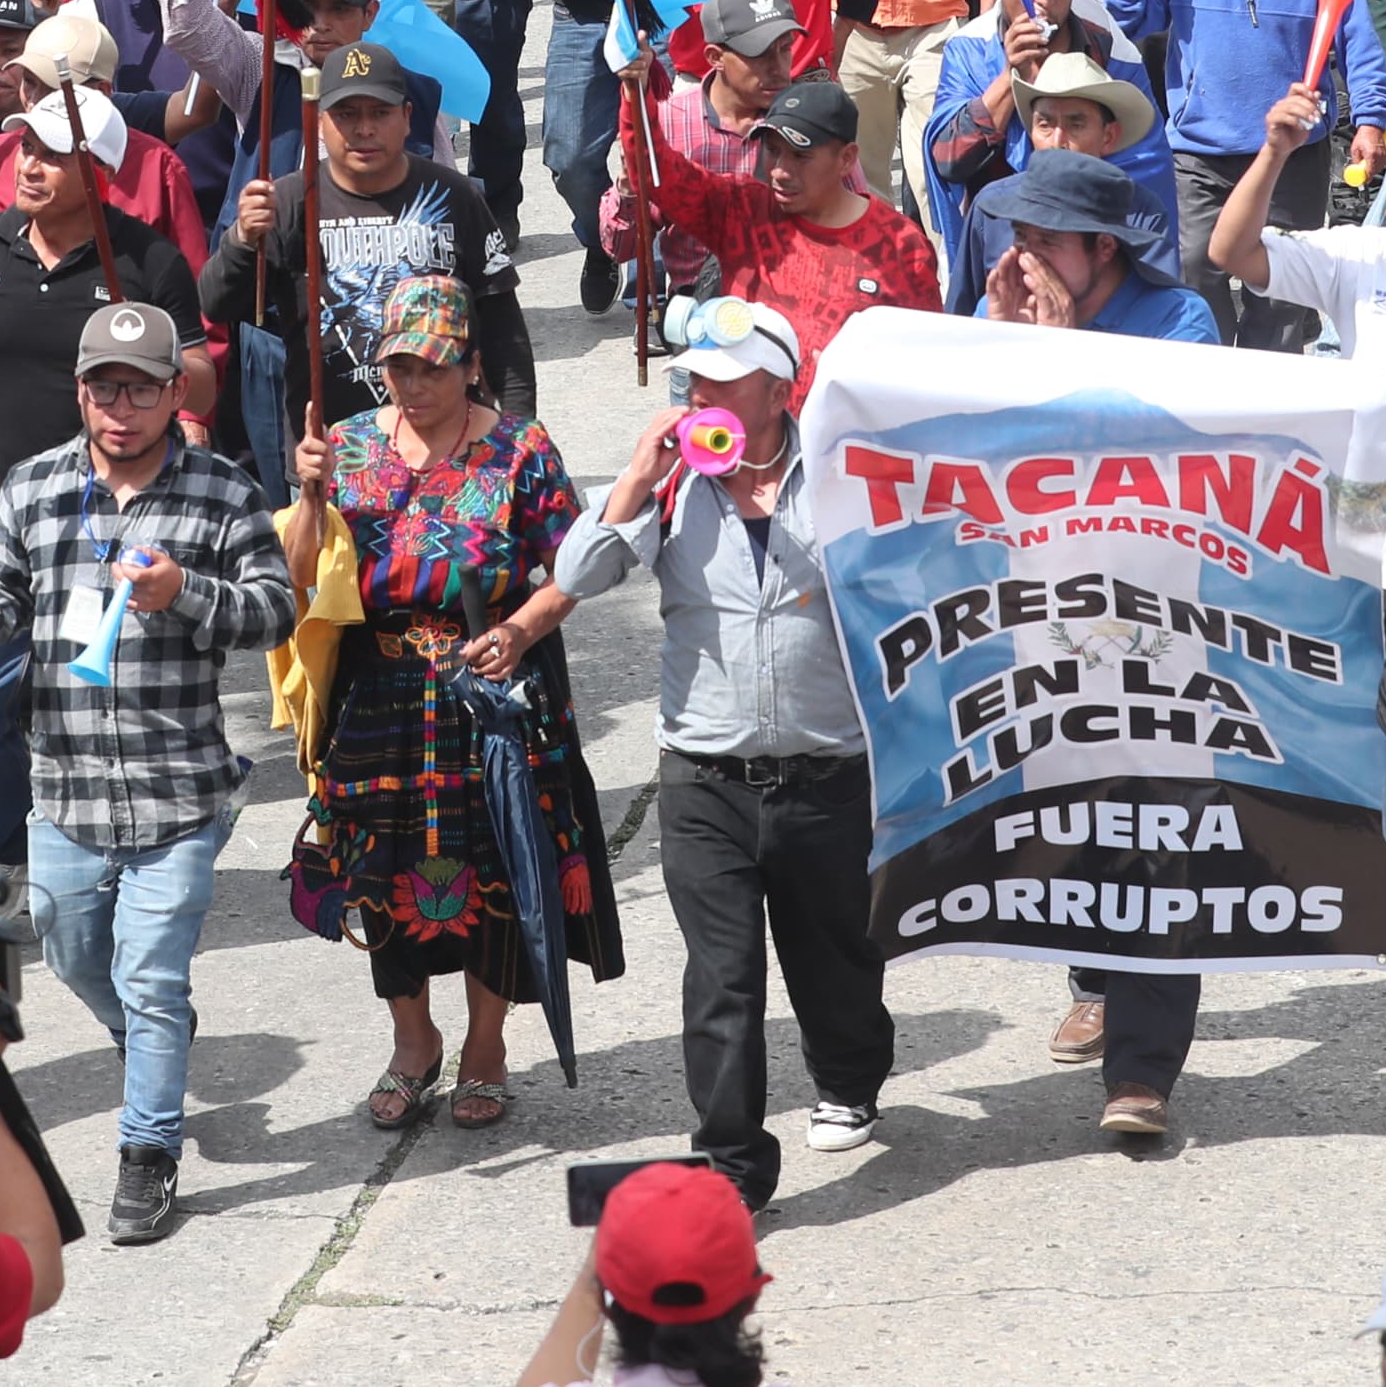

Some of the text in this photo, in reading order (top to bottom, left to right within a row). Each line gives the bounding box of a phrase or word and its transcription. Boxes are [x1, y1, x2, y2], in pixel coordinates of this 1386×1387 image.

[320, 222, 456, 271] OUTHPOLE
[844, 445, 1332, 575] TACANÁ
[959, 516, 1250, 575] SAN MARCOS
[876, 574, 1340, 696] PRESENTE
[954, 658, 1254, 739] EN LA
[944, 705, 1280, 804] LUCHA
[994, 801, 1243, 853] FUERA
[897, 878, 1344, 938] CORRUPTOS
